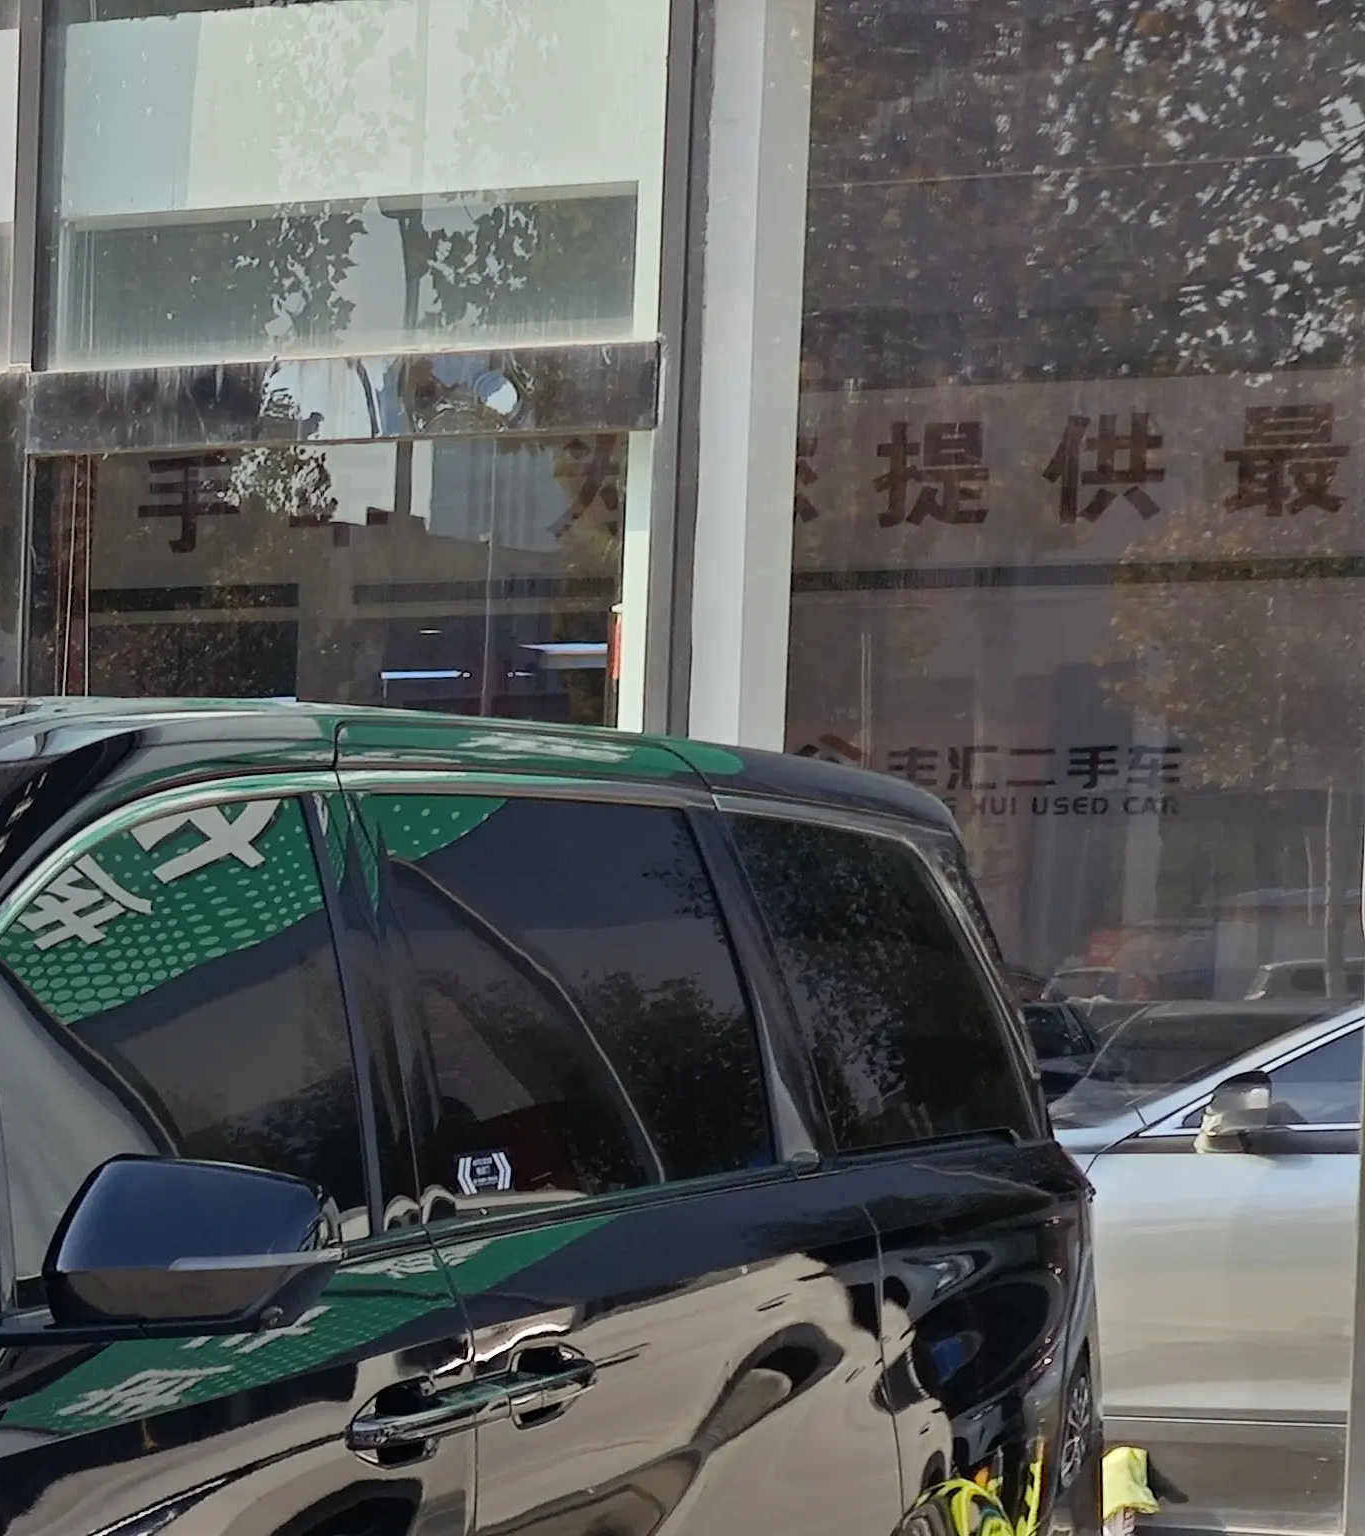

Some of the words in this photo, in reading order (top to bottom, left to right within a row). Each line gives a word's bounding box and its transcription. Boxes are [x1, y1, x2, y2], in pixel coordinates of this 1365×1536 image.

[796, 404, 1349, 528] 提供最
[1031, 796, 1109, 815] USED
[1122, 796, 1180, 815] CAR
